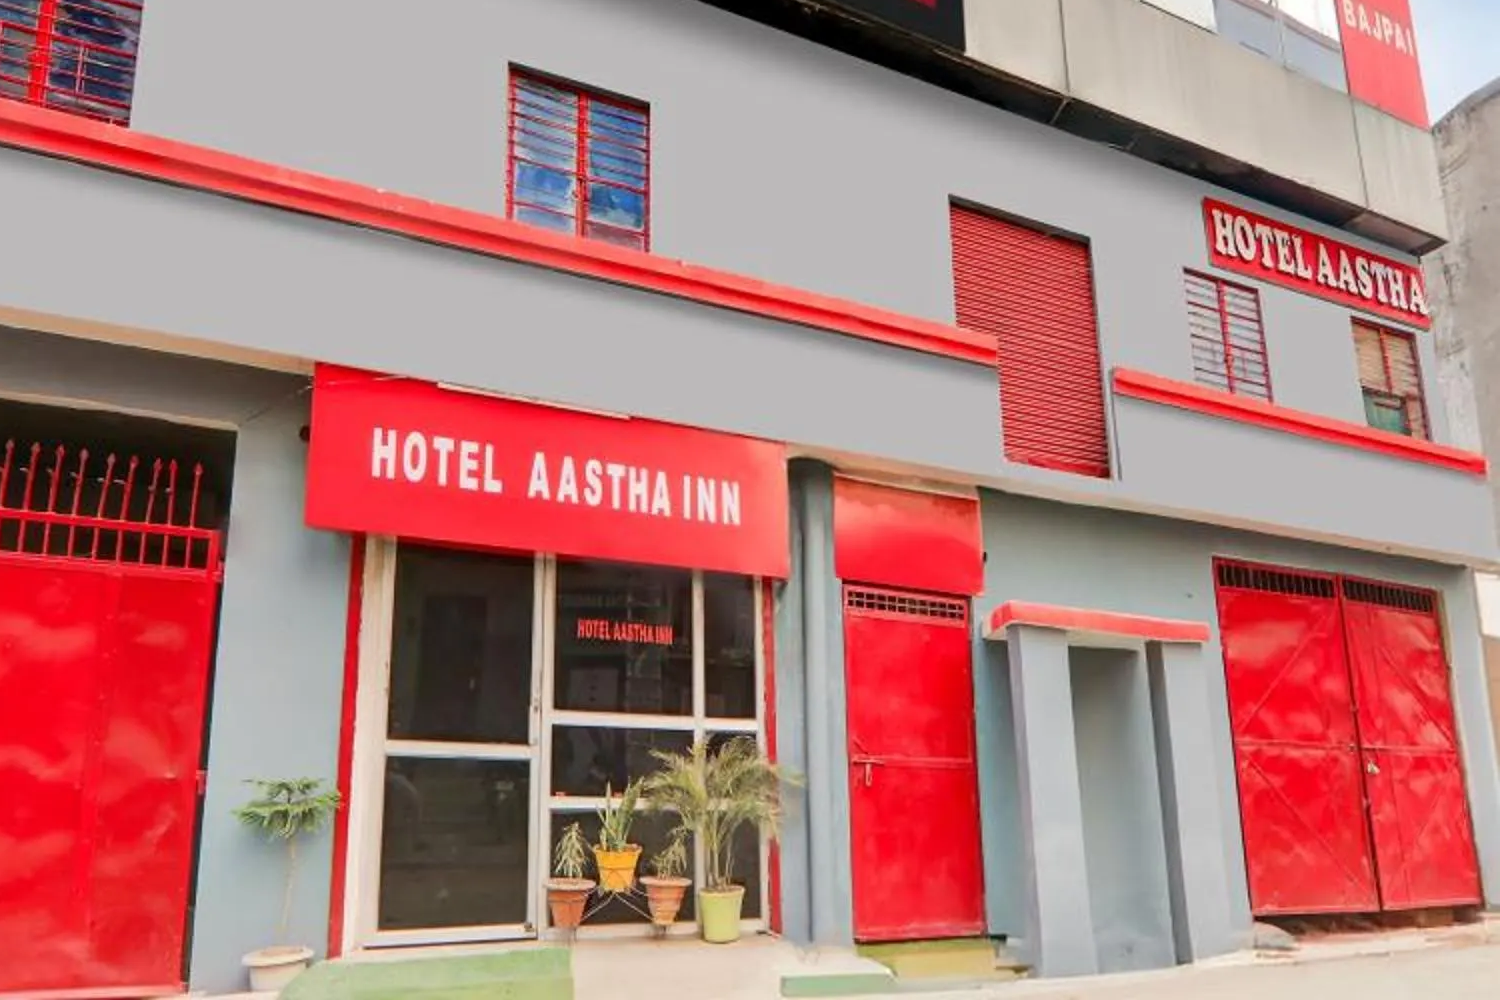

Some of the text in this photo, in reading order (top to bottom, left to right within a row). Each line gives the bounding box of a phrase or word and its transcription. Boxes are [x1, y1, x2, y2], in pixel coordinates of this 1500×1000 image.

[1211, 208, 1429, 315] HOTEL AASTHA
[371, 427, 741, 526] HOTEL AASTHA INN
[577, 618, 672, 645] HOTEL AASTHA INN
